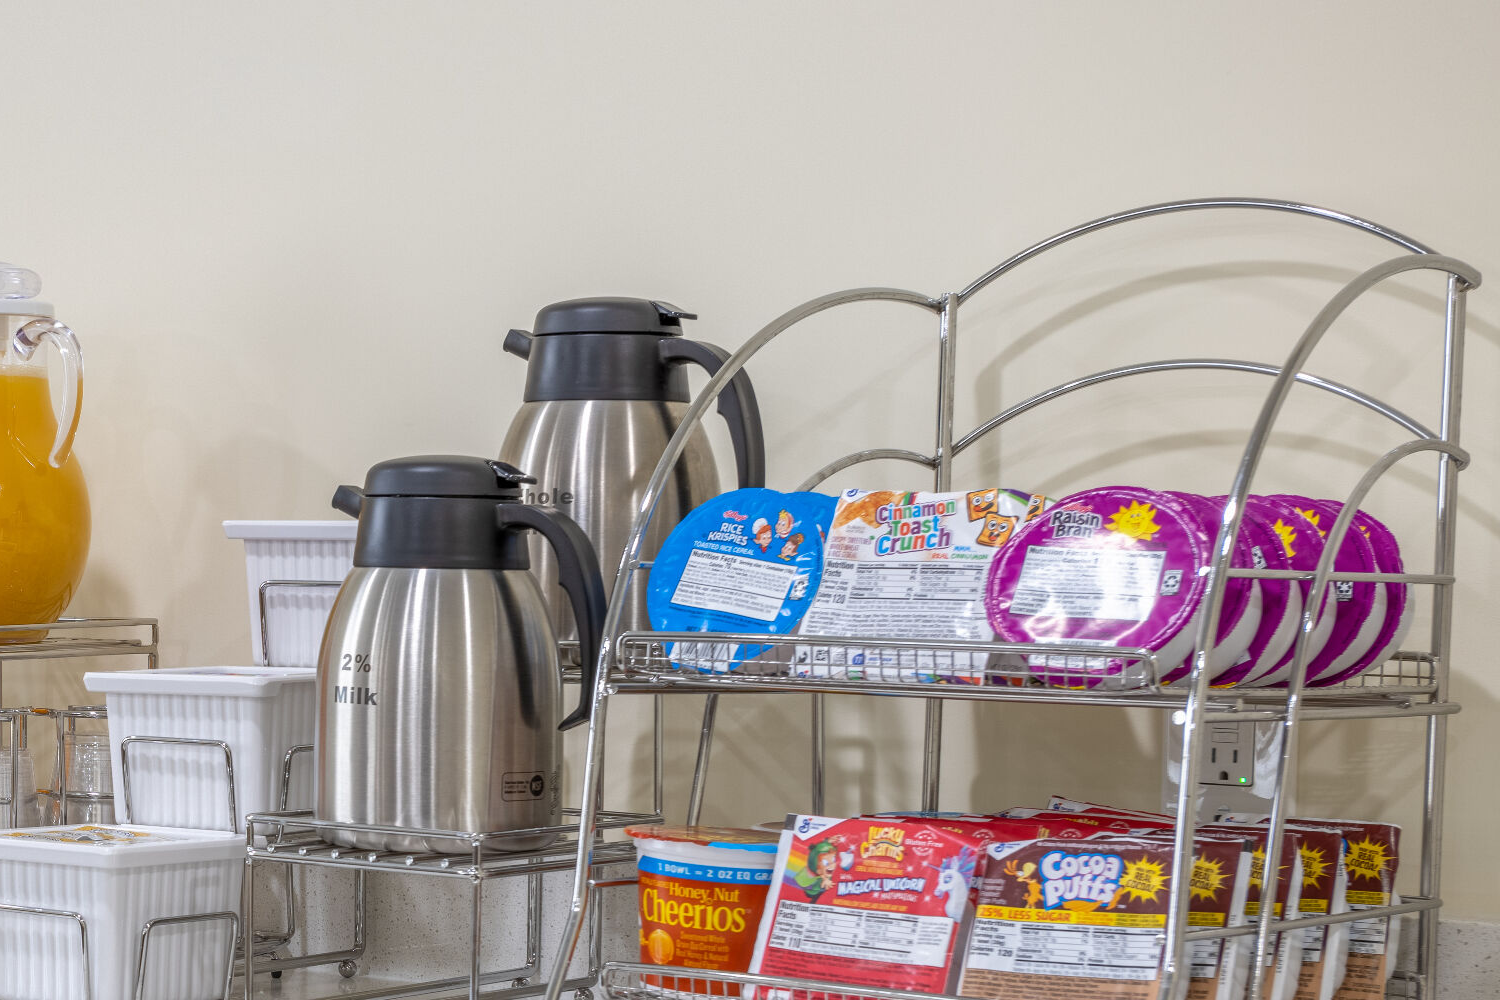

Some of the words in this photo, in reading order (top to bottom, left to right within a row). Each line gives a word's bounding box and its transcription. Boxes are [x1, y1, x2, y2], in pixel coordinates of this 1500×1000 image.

[521, 486, 574, 505] hole
[877, 500, 956, 522] Cinnamon
[1051, 510, 1101, 528] Raisin
[720, 522, 744, 534] RICE
[890, 516, 941, 537] Toast
[1054, 524, 1093, 538] Bran
[707, 531, 748, 546] KRISPIES
[877, 527, 950, 554] Crunch
[341, 653, 372, 673] 2%
[334, 685, 378, 706] Milk
[860, 841, 904, 862] Charms
[658, 862, 663, 871] 1
[664, 864, 691, 875] BOWL
[706, 869, 714, 877] 2
[736, 871, 751, 880] EQ
[1041, 852, 1120, 881] Cocoa
[669, 882, 710, 903] Honey
[713, 887, 740, 903] Nut
[837, 878, 882, 896] MAGICAL
[643, 887, 746, 933] Cheerios
[1007, 909, 1032, 920] LESS
[1035, 911, 1071, 922] SUGAR
